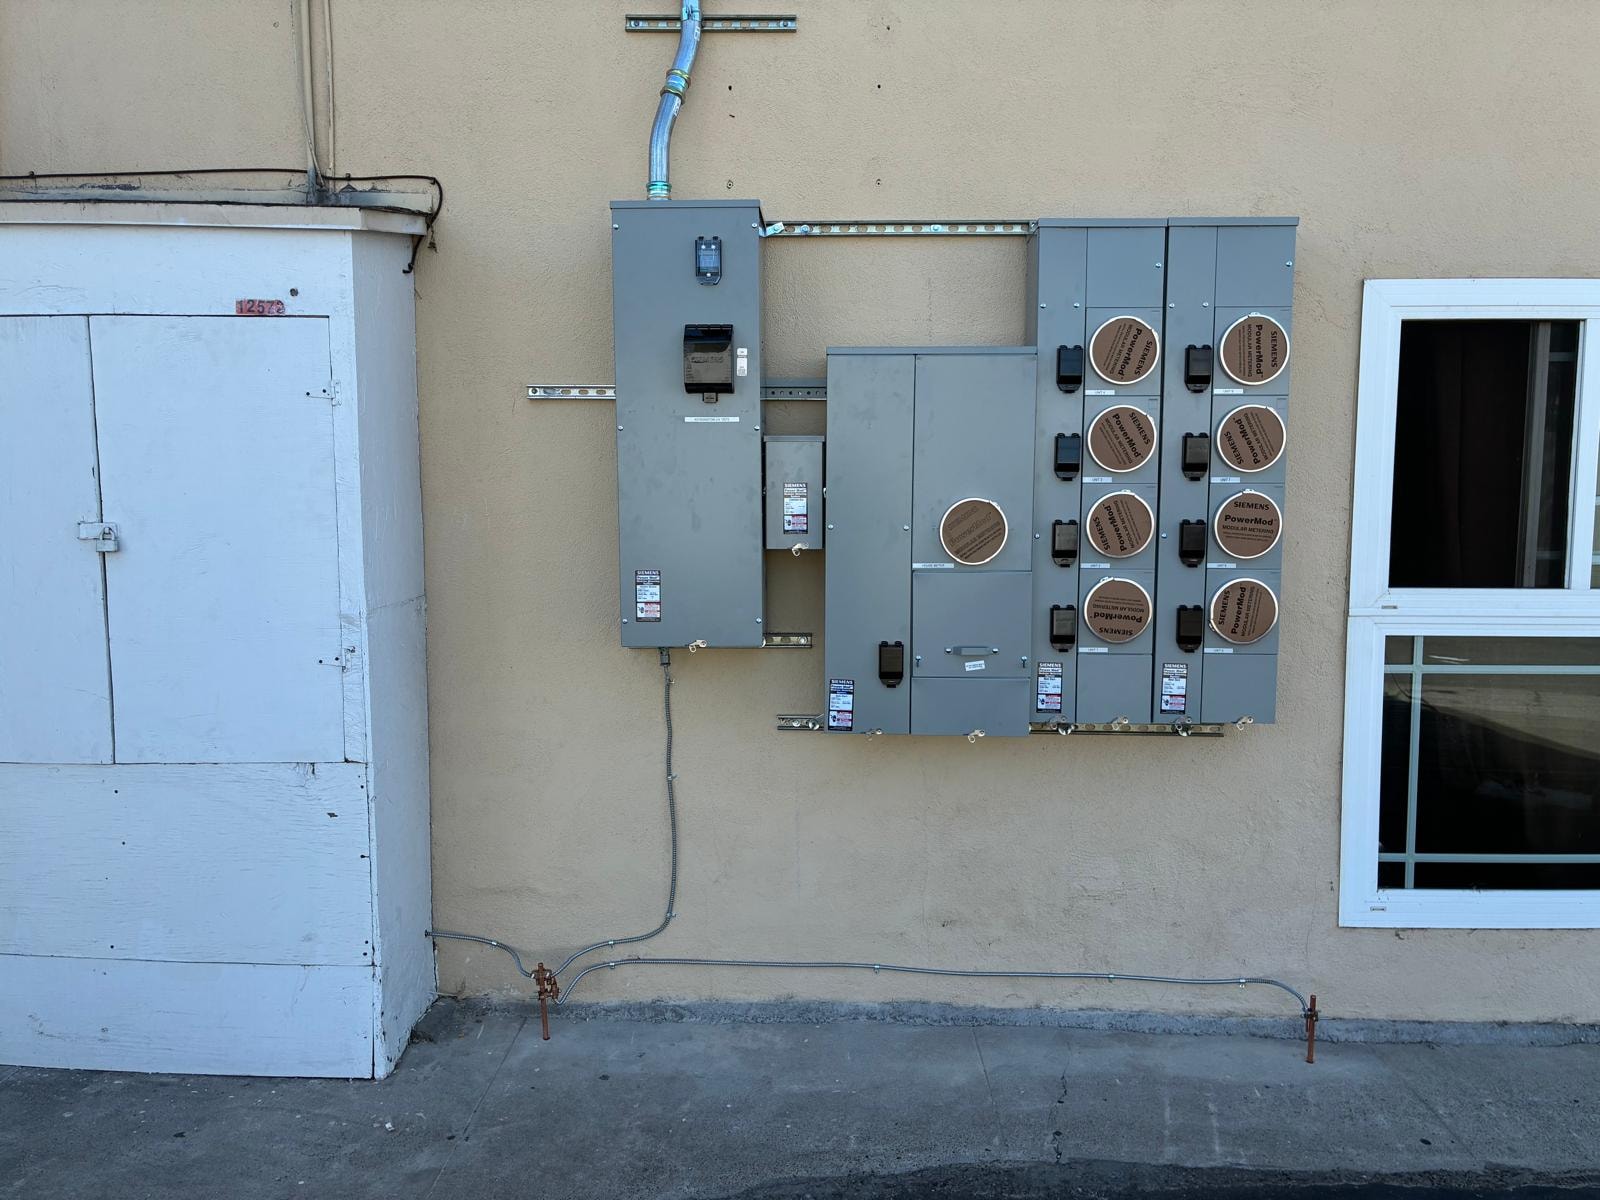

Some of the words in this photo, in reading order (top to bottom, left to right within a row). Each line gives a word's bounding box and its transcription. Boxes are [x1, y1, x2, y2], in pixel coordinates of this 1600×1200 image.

[1134, 340, 1153, 376] SIEMENS
[1270, 331, 1278, 368] SIEMENS
[1129, 412, 1151, 445] SIEMENS
[1224, 431, 1244, 465] SIEMENS
[1234, 501, 1270, 511] SIEMENS
[1092, 516, 1110, 551] SIEMENS
[1218, 590, 1231, 625] SIEMENS
[1099, 627, 1134, 636] SIEMENS
